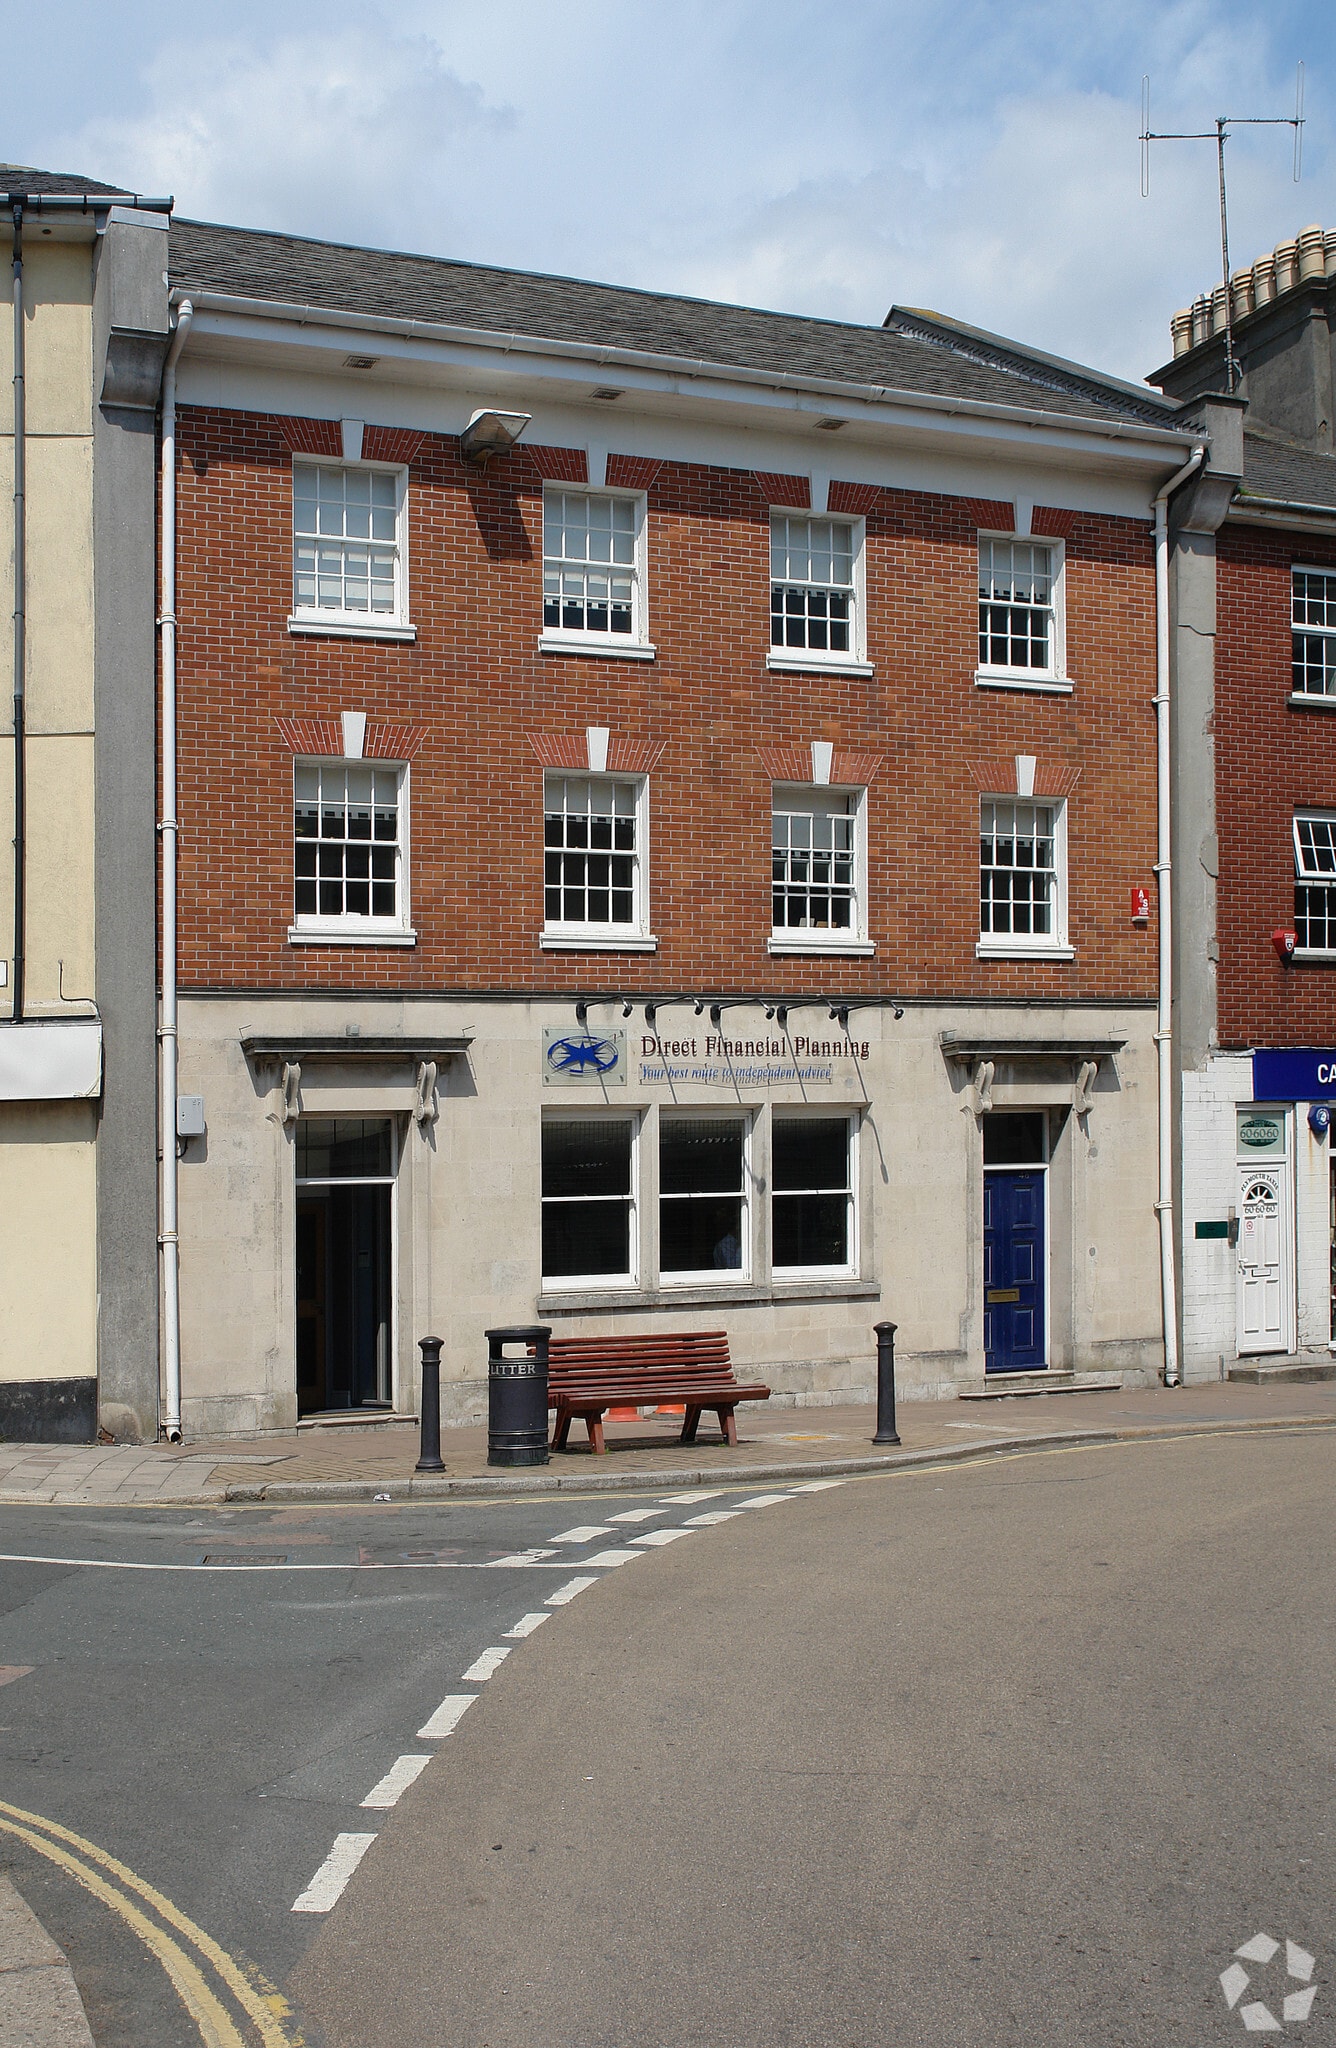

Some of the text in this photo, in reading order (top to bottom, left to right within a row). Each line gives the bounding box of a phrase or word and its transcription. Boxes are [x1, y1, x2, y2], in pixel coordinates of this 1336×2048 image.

[641, 1036, 870, 1060] Direct Financial Planning
[642, 1065, 831, 1080] Your best route to independent advice
[1241, 1173, 1265, 1192] PLYMOUTH
[491, 1365, 536, 1375] LITTER
